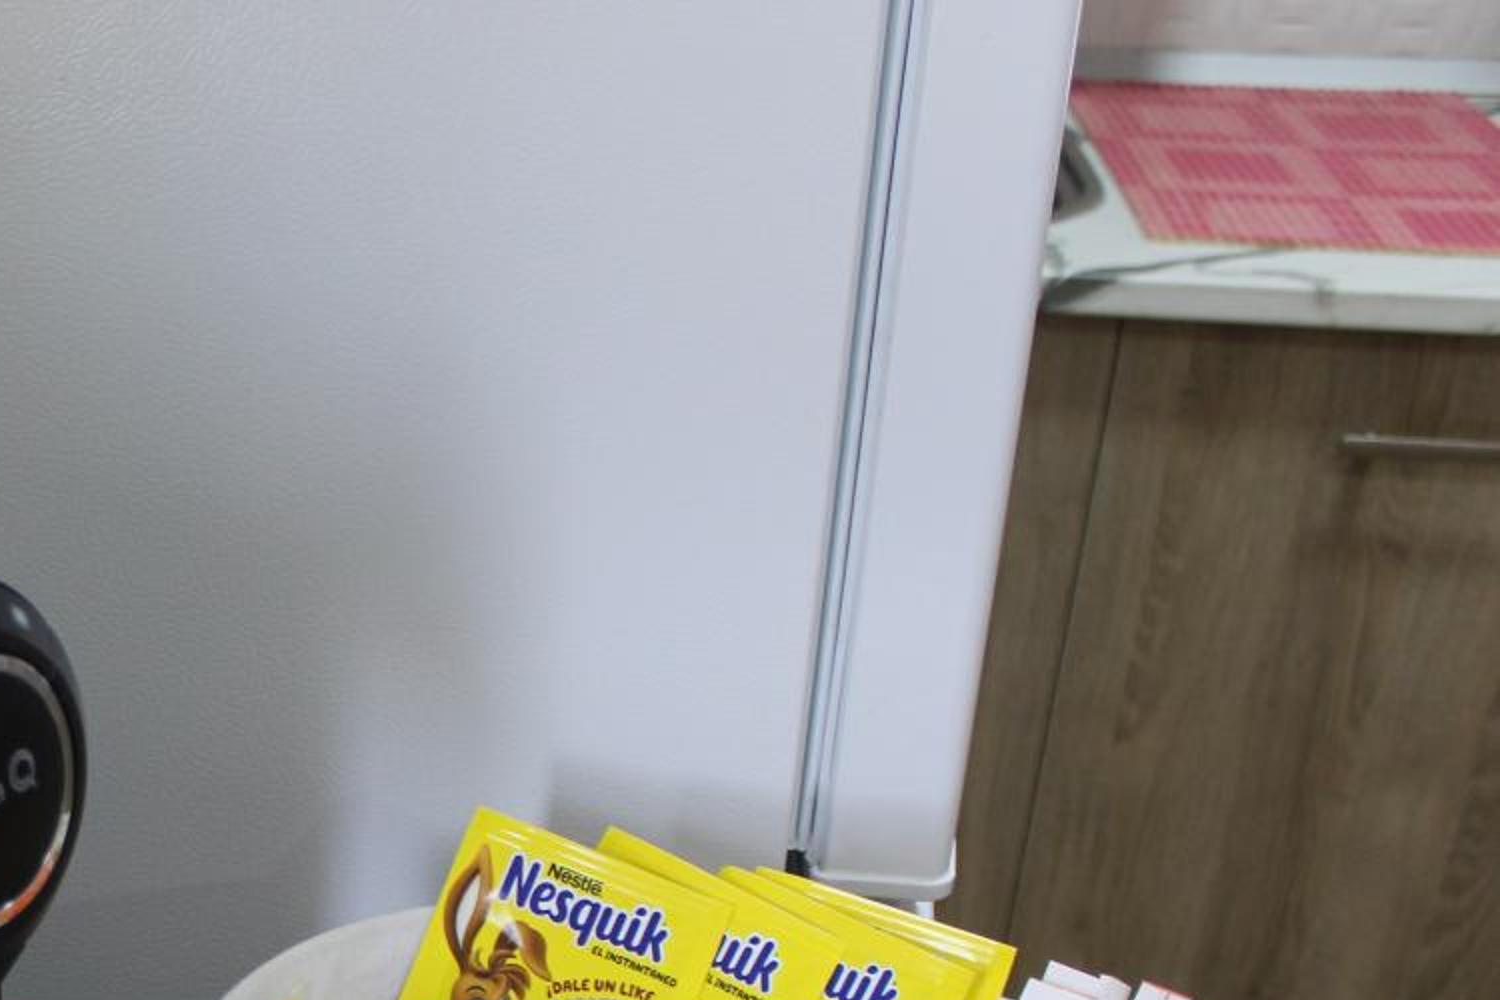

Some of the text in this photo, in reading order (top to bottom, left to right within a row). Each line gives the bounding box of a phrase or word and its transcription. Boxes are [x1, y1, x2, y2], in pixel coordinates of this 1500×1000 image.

[8, 749, 37, 794] Q
[499, 855, 668, 963] Nesquik
[594, 979, 616, 993] UN
